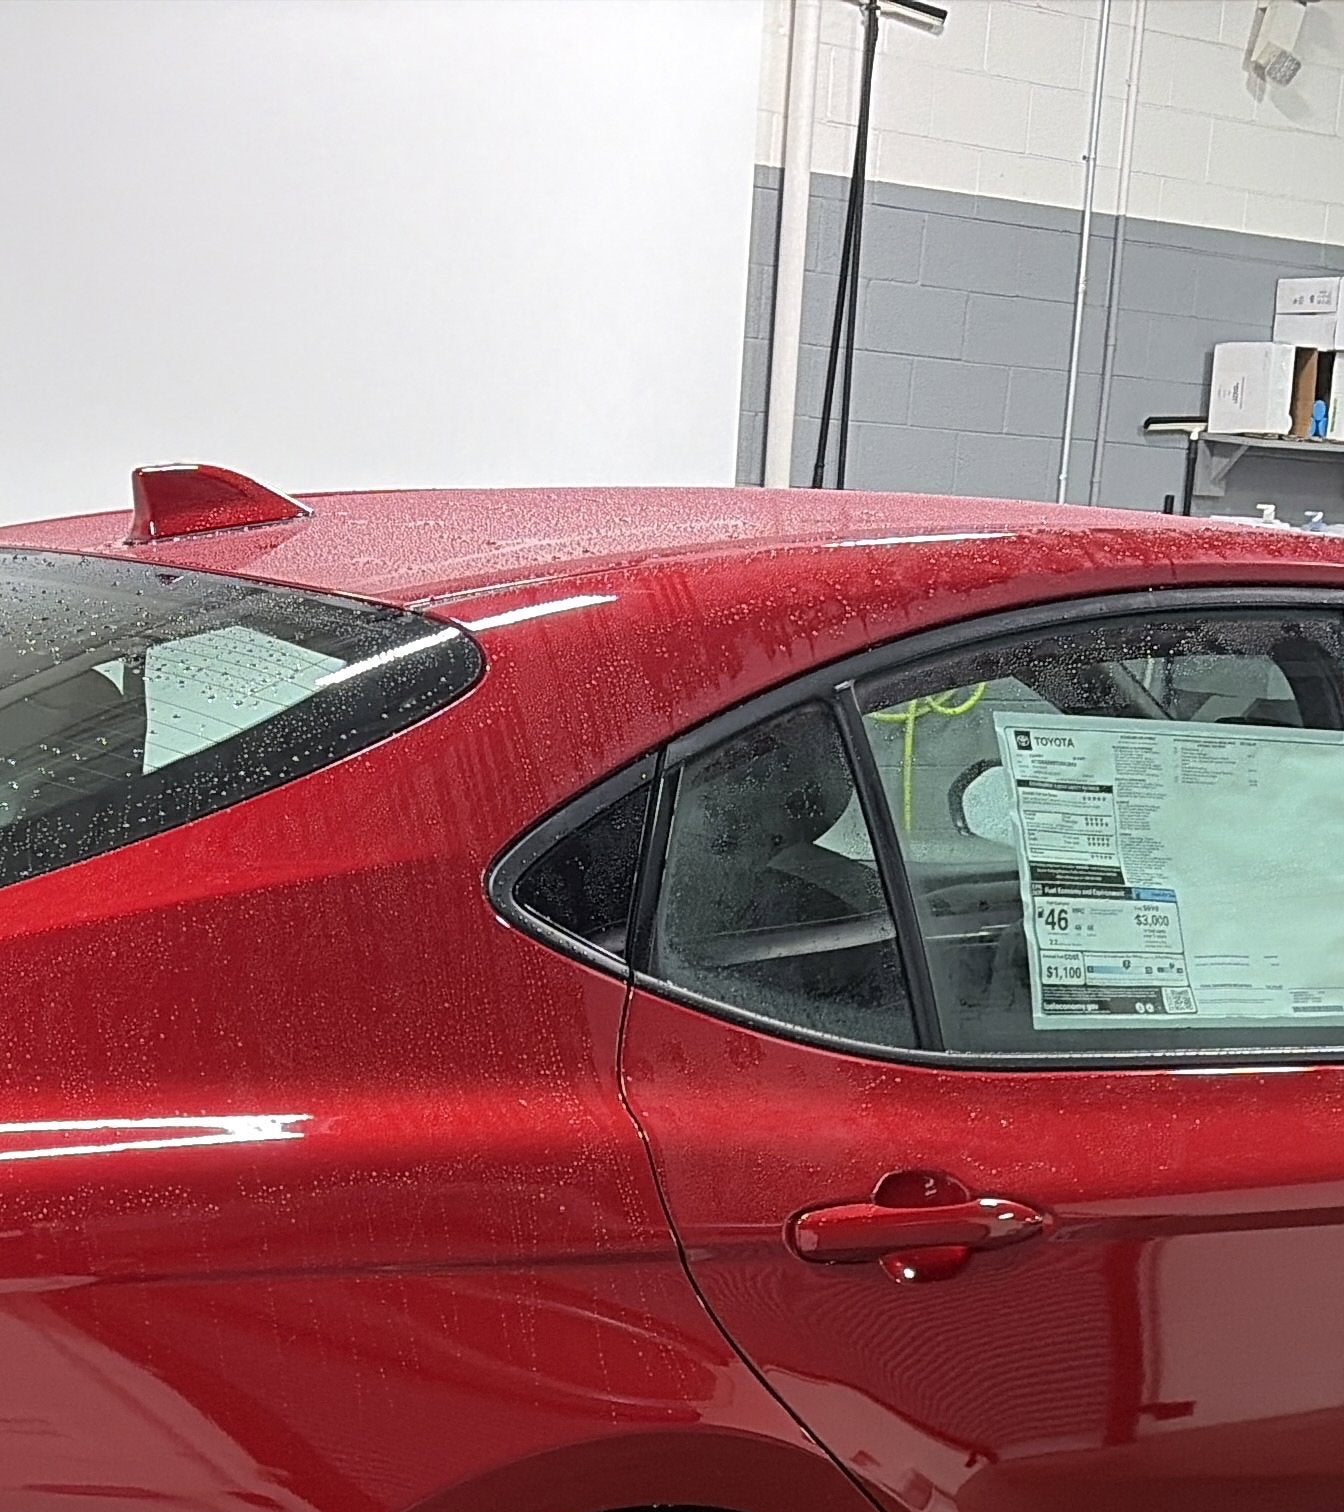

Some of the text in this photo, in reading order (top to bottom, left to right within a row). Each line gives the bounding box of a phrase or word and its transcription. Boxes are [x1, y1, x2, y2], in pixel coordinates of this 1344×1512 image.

[1033, 735, 1076, 749] TOYOTA
[1044, 908, 1069, 932] 46
[1135, 913, 1169, 928] $3,000
[1046, 965, 1082, 981] $1,100
